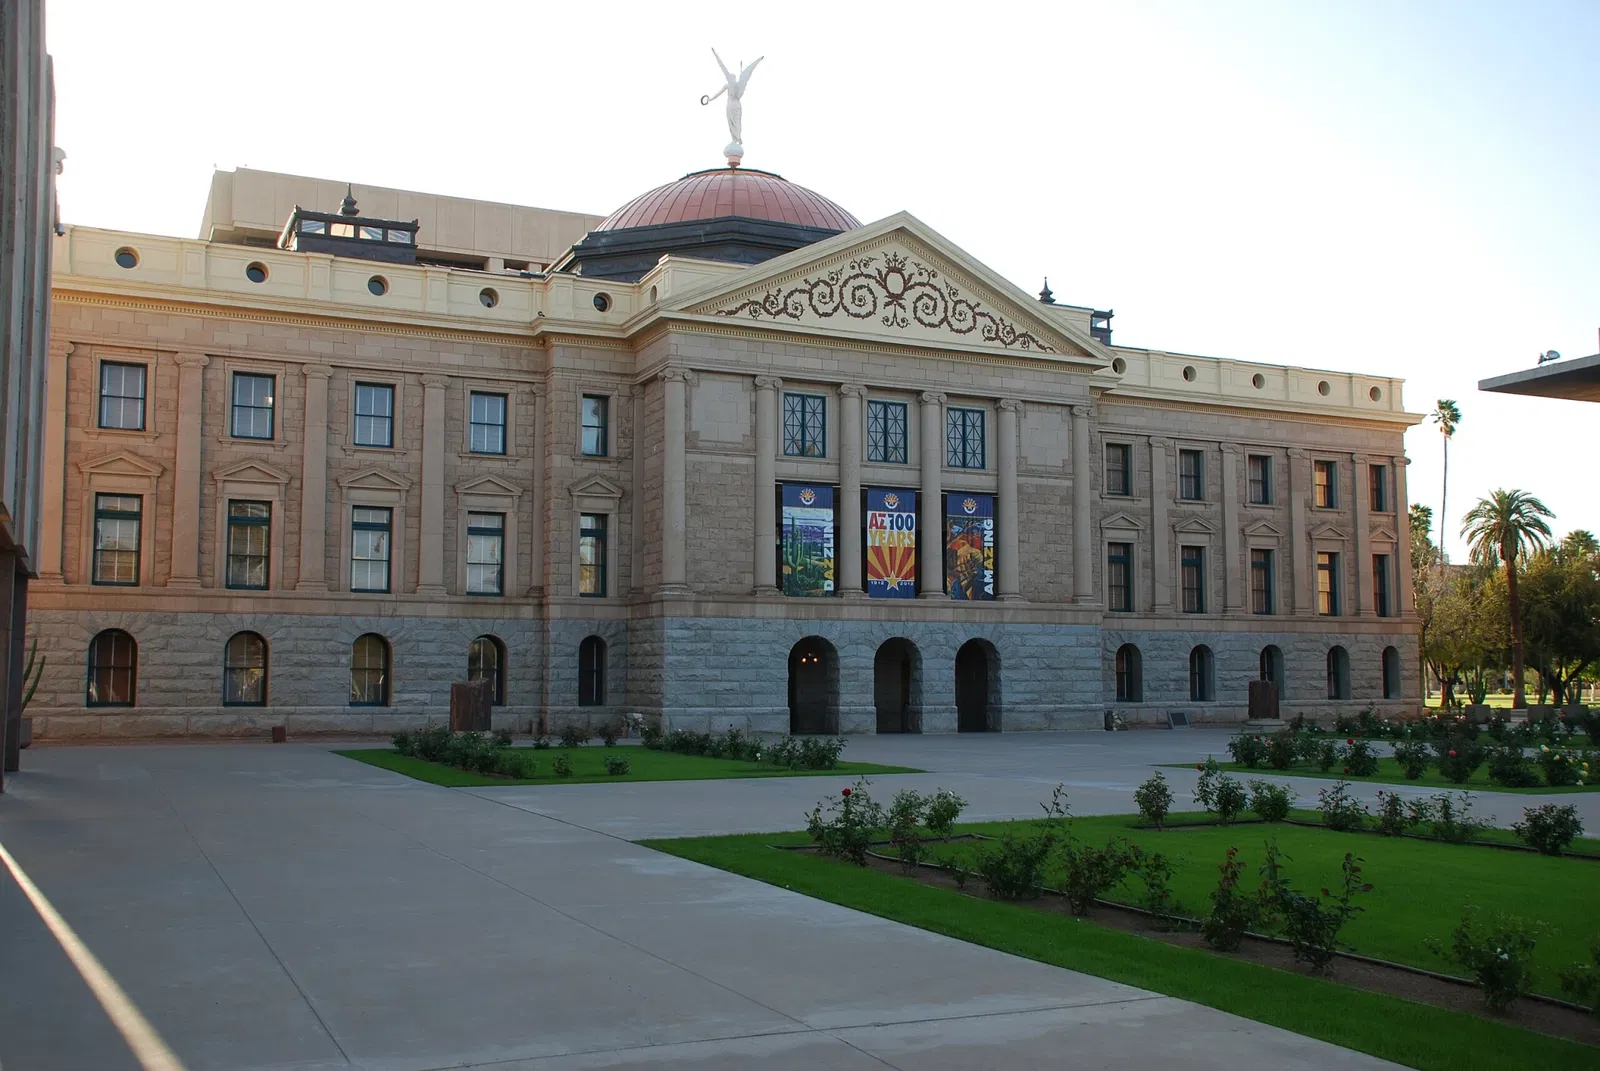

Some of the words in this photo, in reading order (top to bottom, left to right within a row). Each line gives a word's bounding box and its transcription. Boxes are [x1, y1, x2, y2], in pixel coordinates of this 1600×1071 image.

[824, 511, 834, 591] DAZZLING
[869, 530, 915, 547] YEARS
[984, 519, 994, 595] AMAZING
